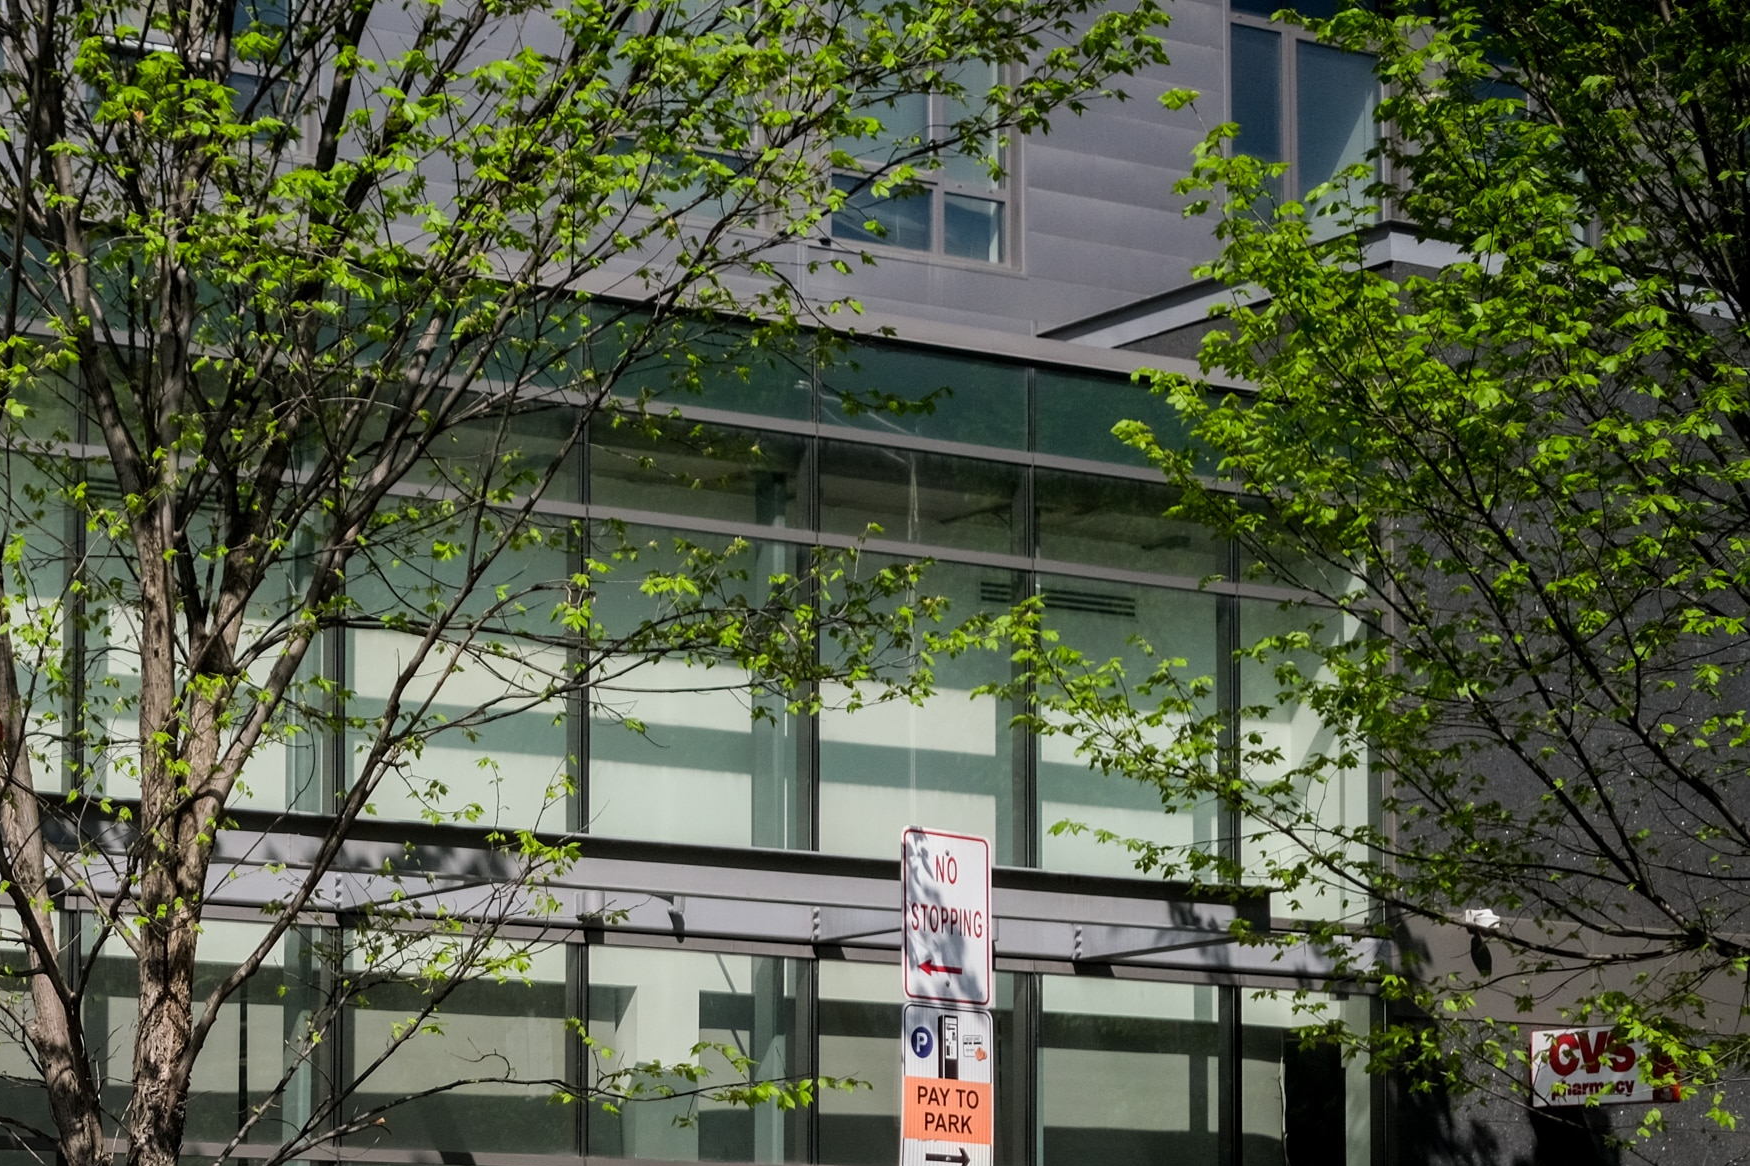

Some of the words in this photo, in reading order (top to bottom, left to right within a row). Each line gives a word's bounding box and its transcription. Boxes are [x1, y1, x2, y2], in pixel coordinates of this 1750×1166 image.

[935, 854, 958, 885] NO
[911, 901, 983, 939] STOPPING
[916, 1032, 929, 1053] P
[1549, 1030, 1636, 1077] CVS
[917, 1085, 951, 1107] PAY
[955, 1088, 979, 1110] TO
[1551, 1080, 1635, 1101] harmcy
[924, 1111, 973, 1135] PARK
